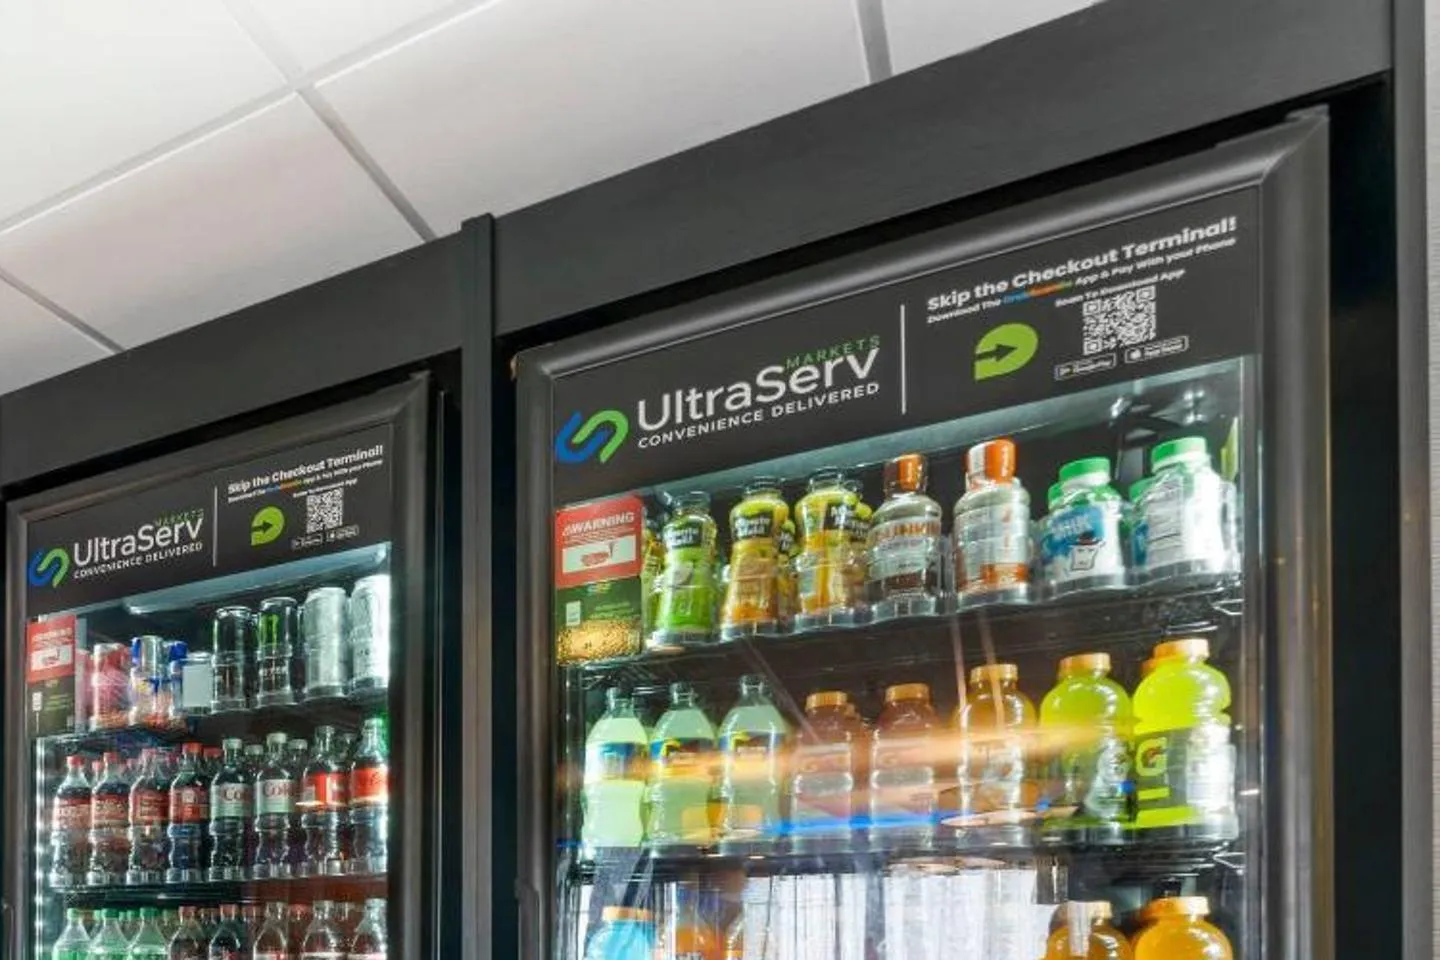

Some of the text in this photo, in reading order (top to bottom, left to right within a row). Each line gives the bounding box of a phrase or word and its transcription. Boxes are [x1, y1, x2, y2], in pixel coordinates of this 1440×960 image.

[927, 290, 970, 312] Skip
[974, 279, 1009, 299] the
[1011, 251, 1119, 287] Checkout
[1122, 216, 1238, 259] Terminal!
[785, 335, 881, 369] MARKETS
[636, 347, 881, 432] UltraServ
[637, 381, 881, 449] CONVENIENCE DELIVERED
[227, 480, 251, 495] Skip
[252, 474, 271, 488] the
[271, 459, 326, 483] Checkout
[327, 444, 384, 469] Terminal!
[73, 518, 204, 569] UltraServ
[569, 512, 635, 535] WARNING
[73, 541, 204, 580] CONVENIENCE DELIVERED
